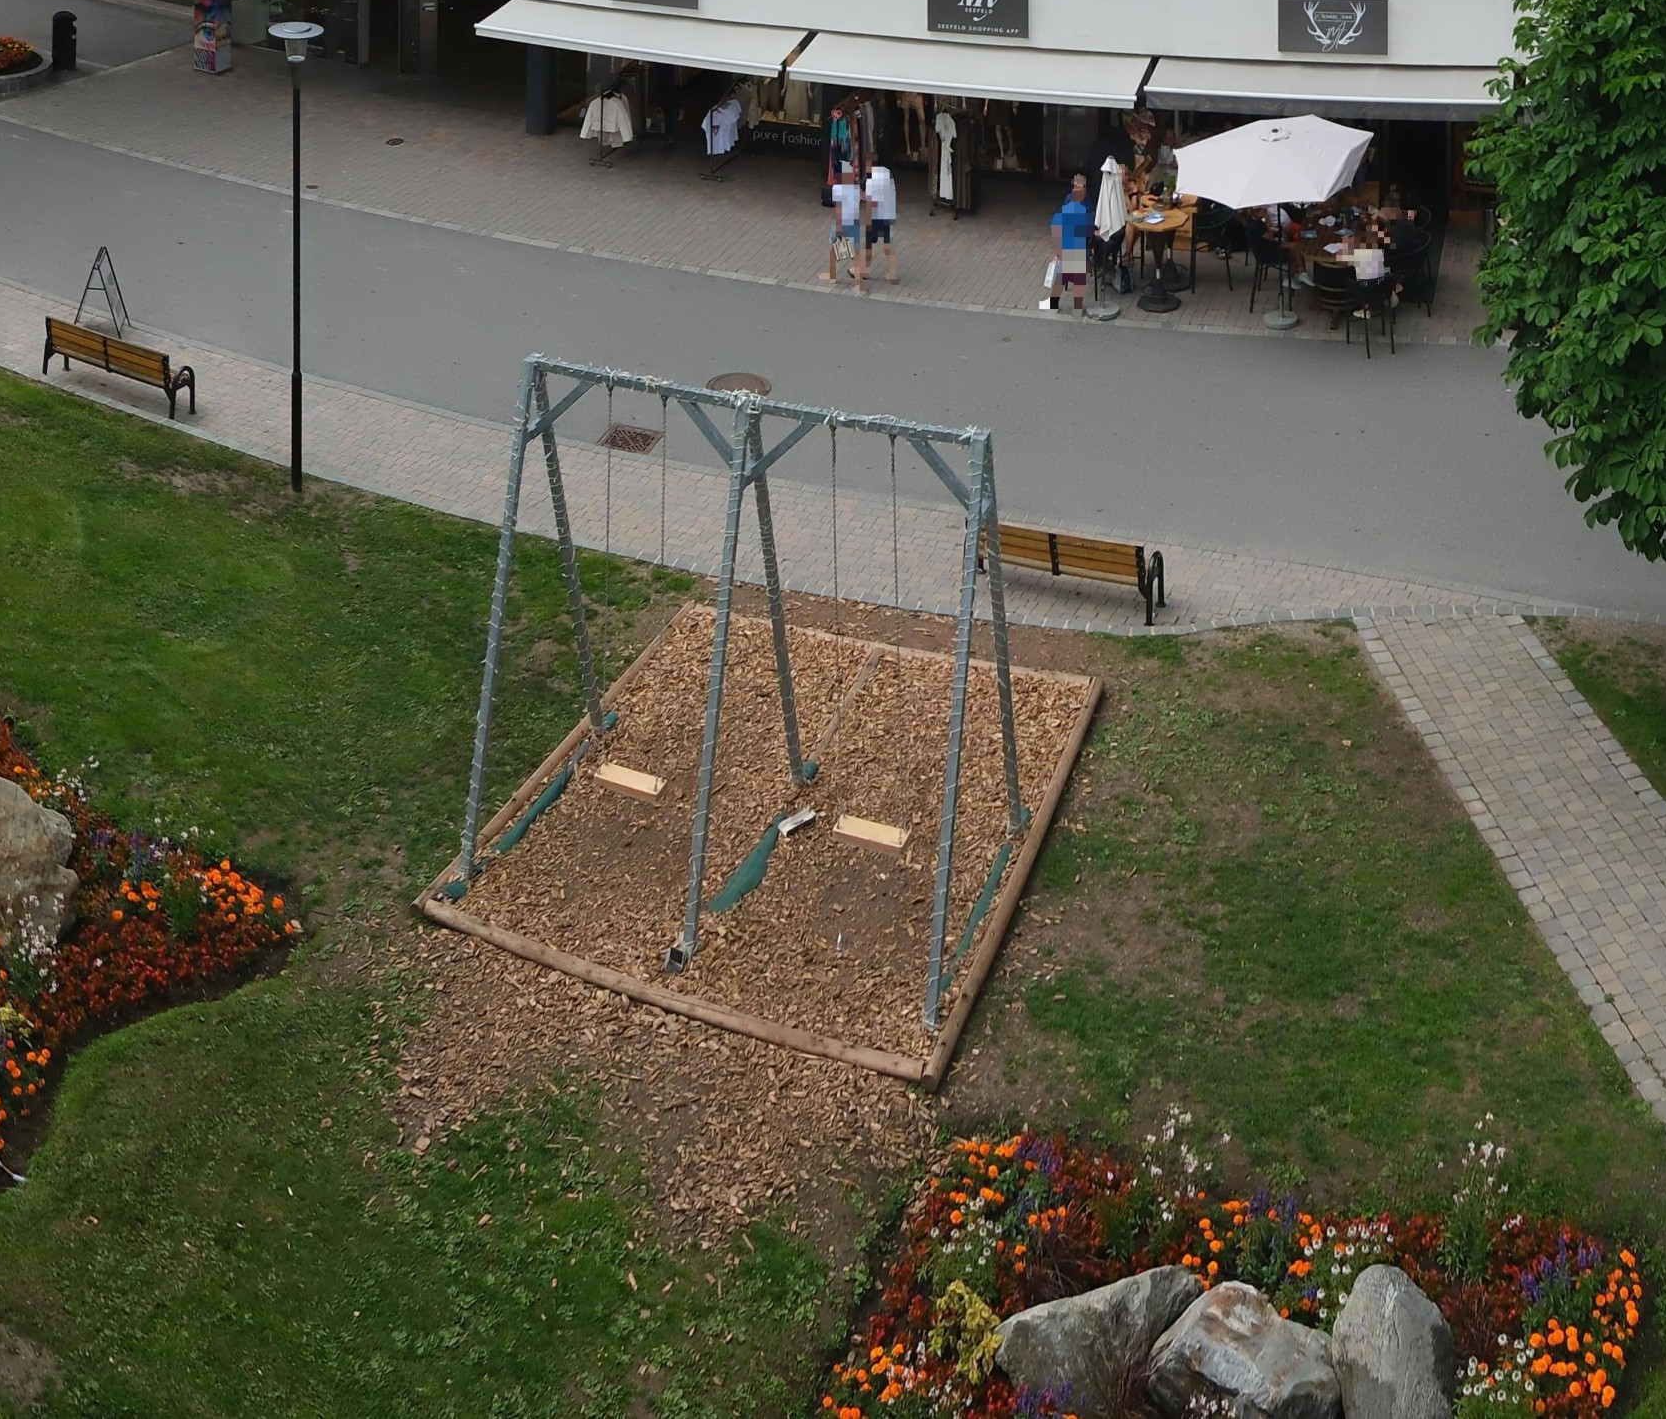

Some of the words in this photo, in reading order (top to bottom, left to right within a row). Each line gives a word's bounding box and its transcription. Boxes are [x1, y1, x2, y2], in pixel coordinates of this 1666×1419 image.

[937, 23, 966, 31] SEEFELD
[968, 25, 1004, 33] SHOPPING
[753, 130, 779, 141] pure
